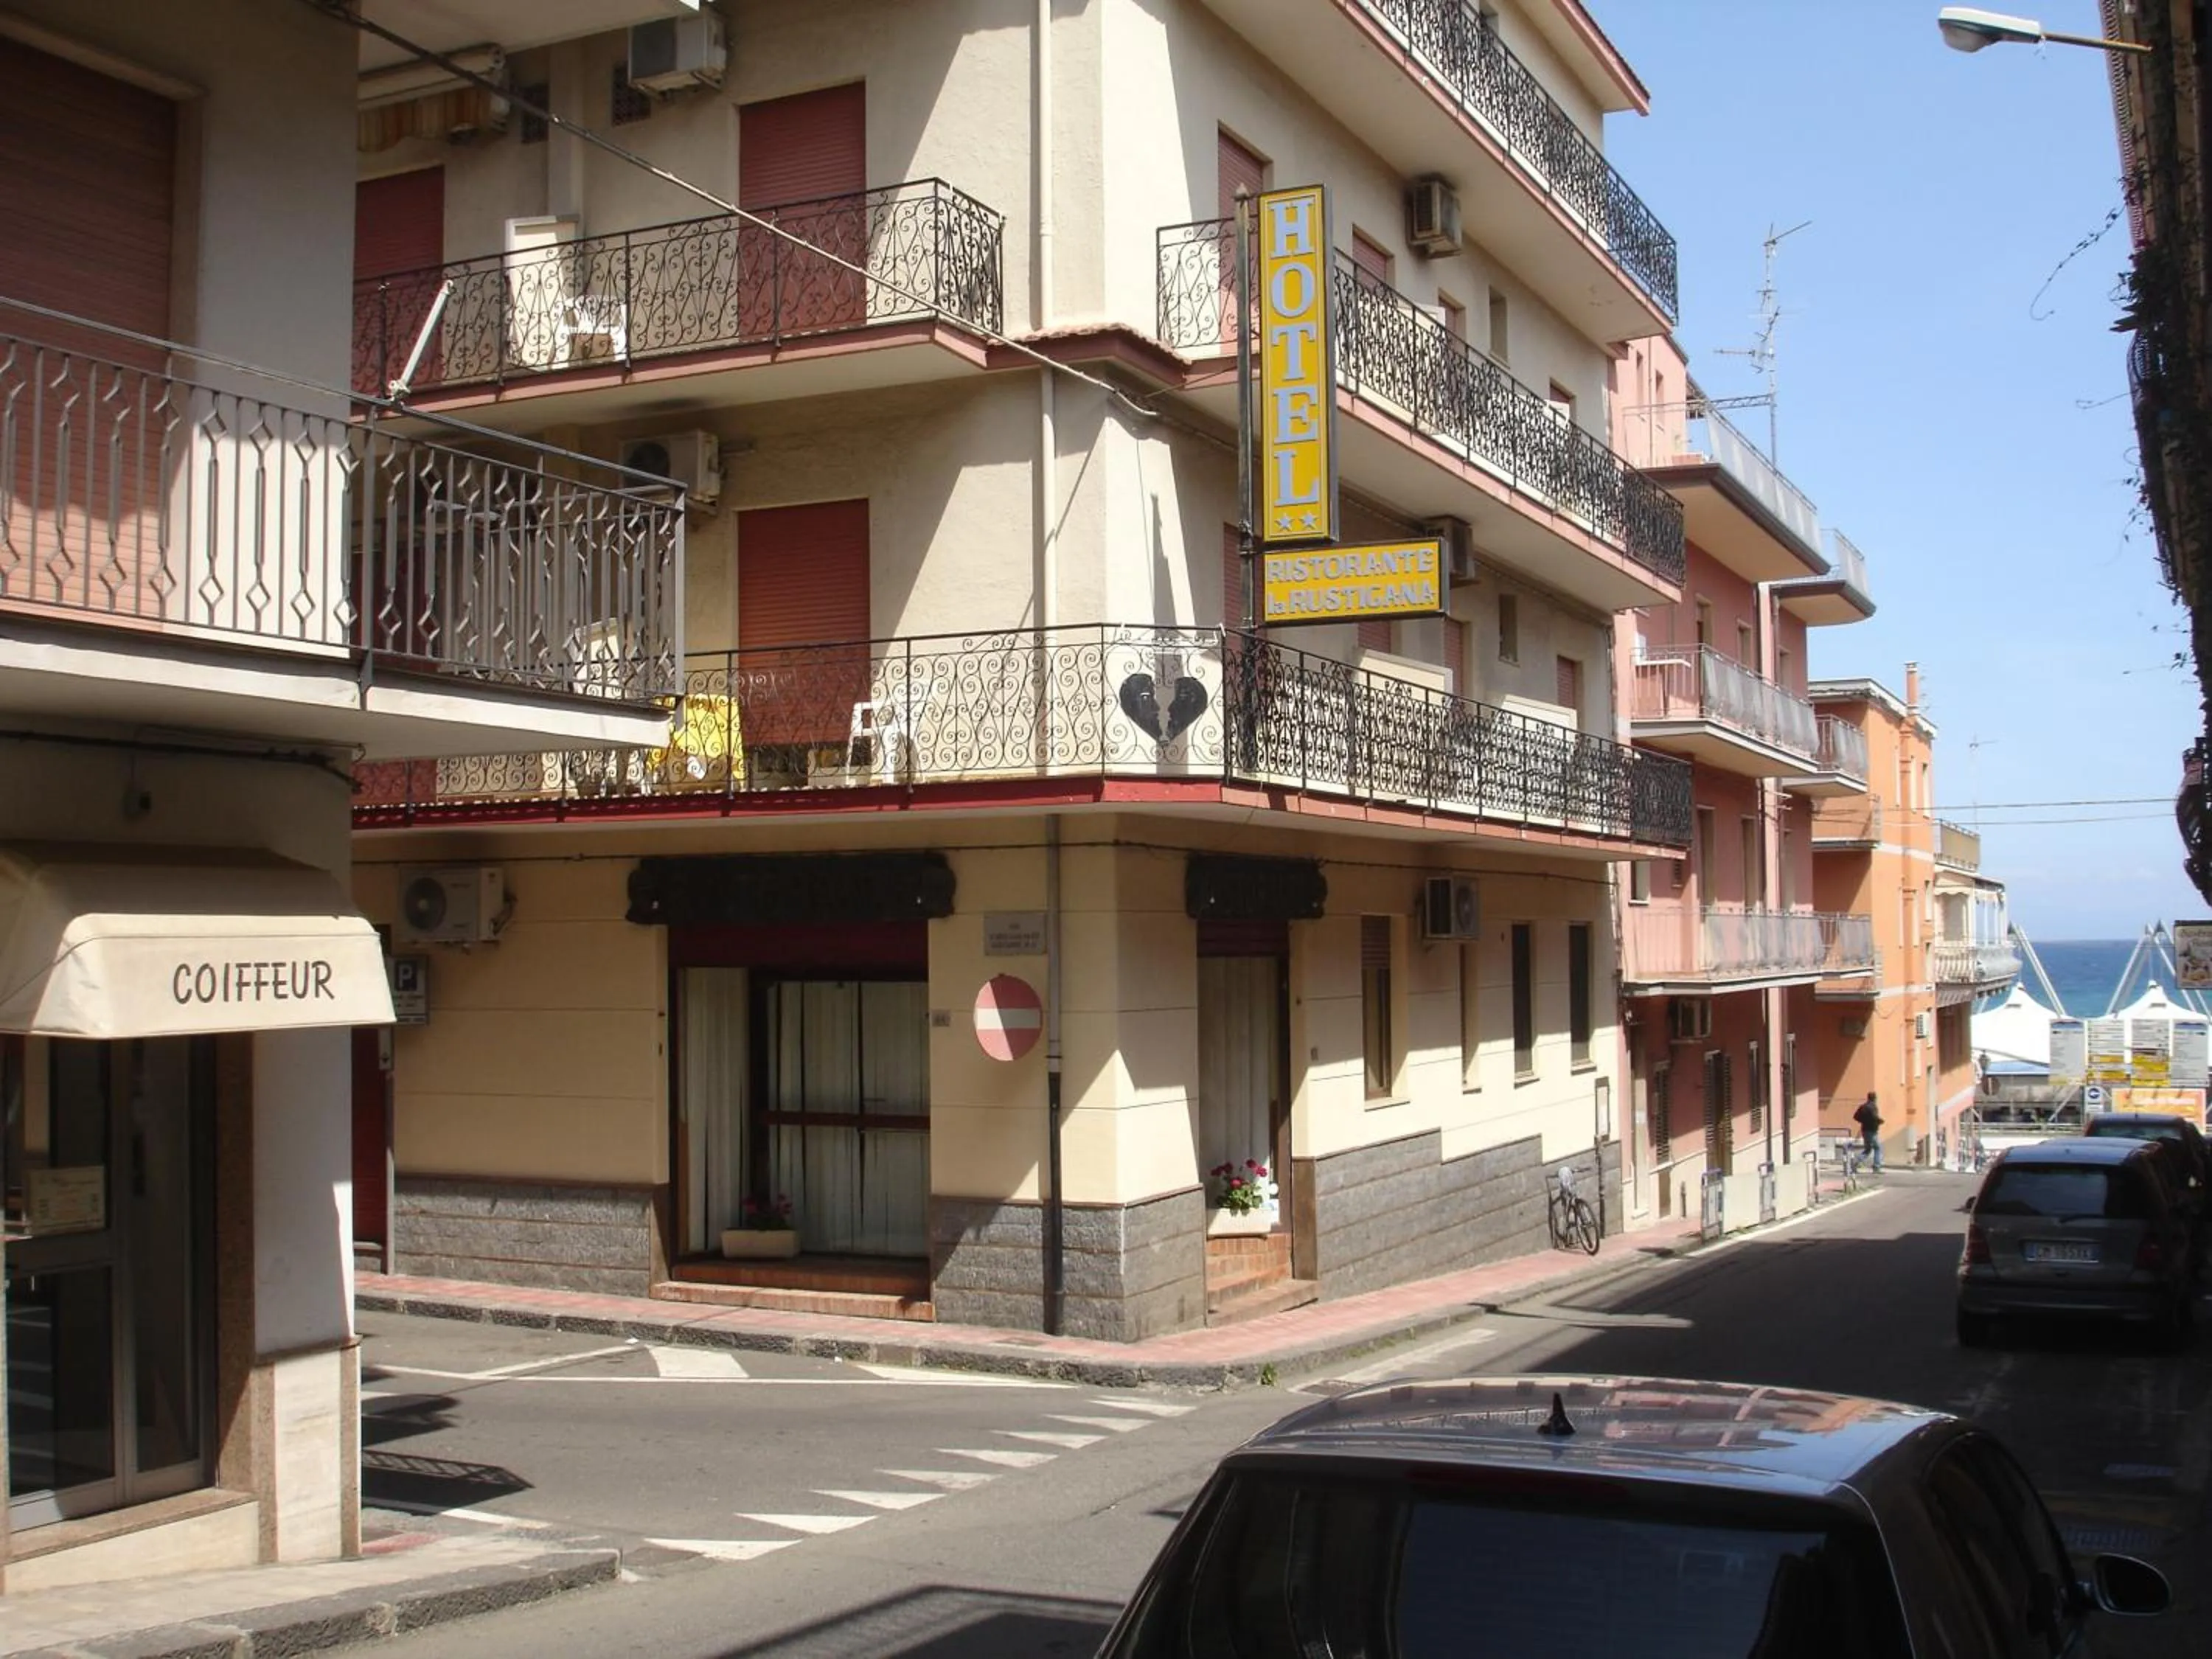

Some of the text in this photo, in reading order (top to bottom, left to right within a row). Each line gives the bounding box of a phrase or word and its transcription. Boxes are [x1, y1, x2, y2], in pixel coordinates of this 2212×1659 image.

[1269, 196, 1320, 506] HOTEL
[1267, 548, 1433, 582] RISTORANTE
[1289, 580, 1436, 613] RUSTICANA
[173, 961, 335, 1004] COIFFEUR
[398, 964, 413, 988] P
